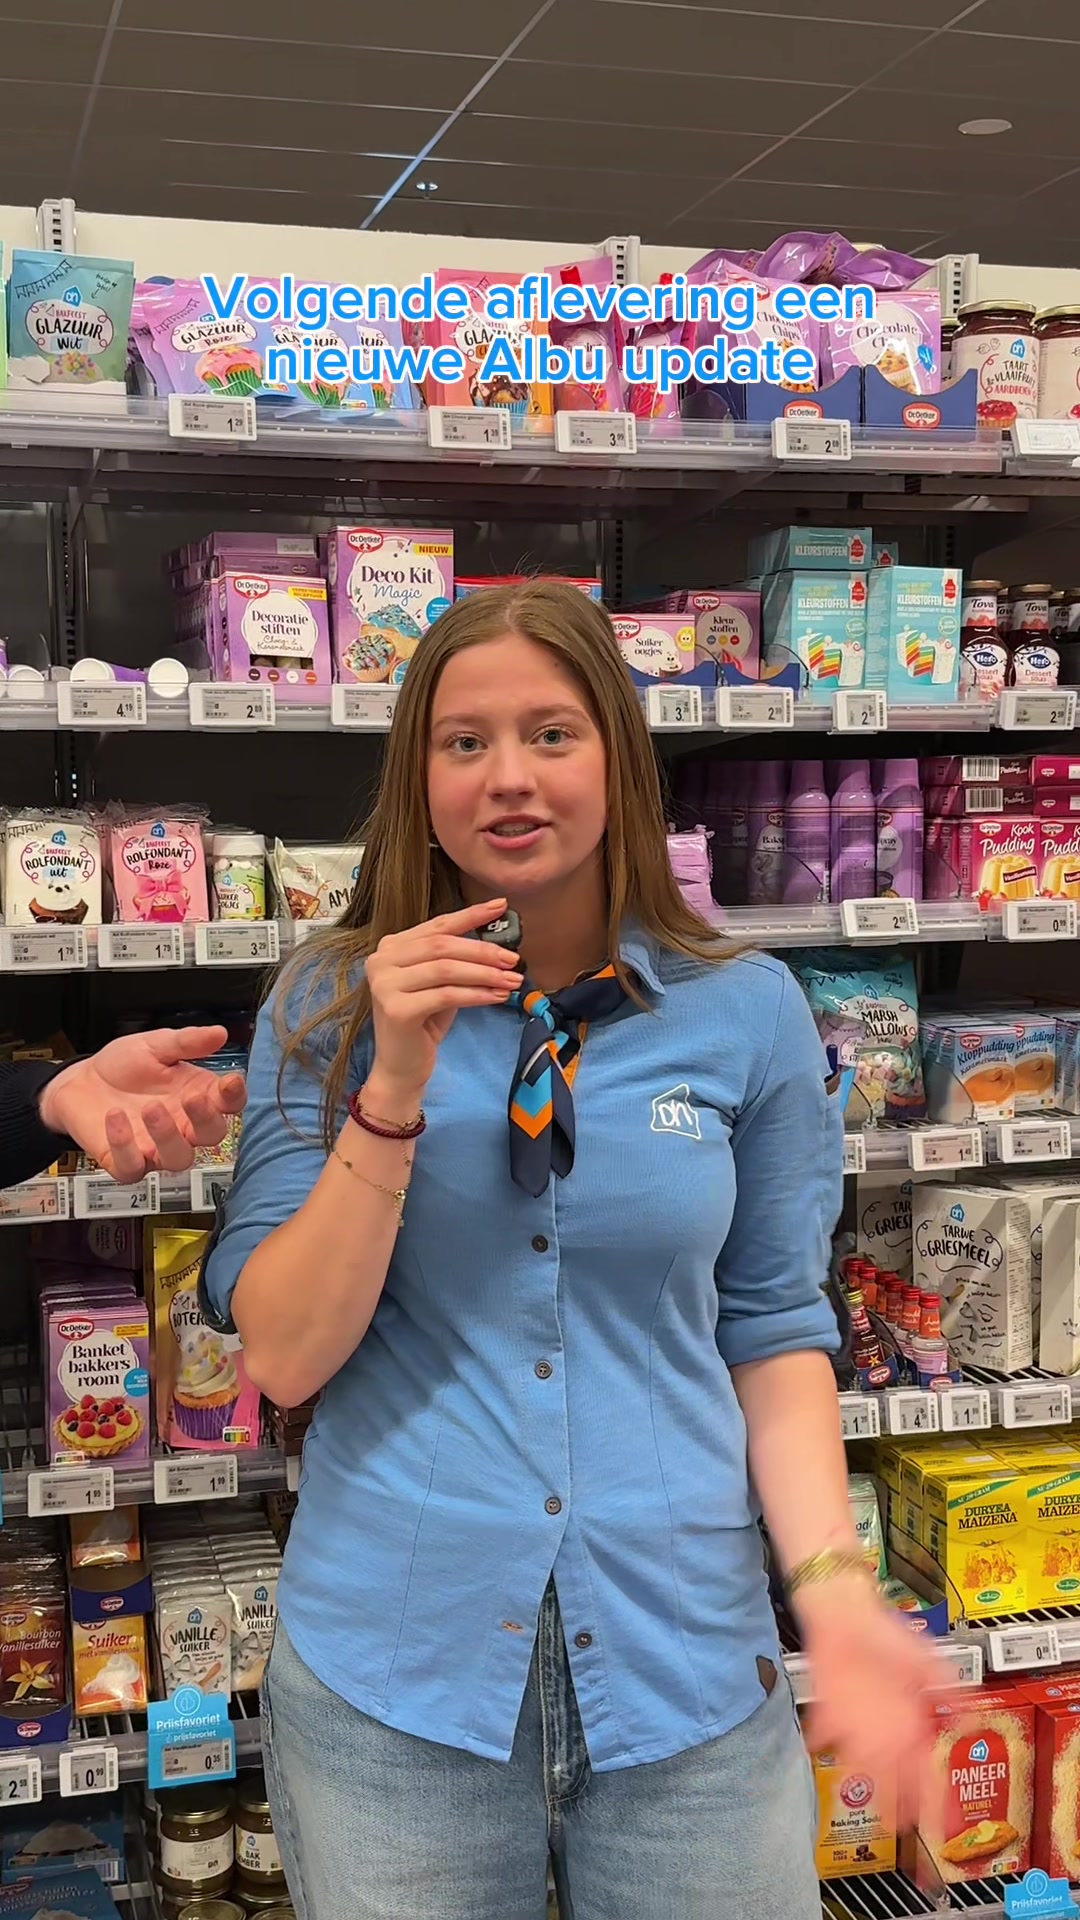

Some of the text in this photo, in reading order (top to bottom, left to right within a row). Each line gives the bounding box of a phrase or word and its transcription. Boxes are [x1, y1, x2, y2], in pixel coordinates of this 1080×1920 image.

[35, 318, 103, 340] GLAZUUR
[180, 324, 246, 345] GLAZUUR
[57, 337, 83, 350] Wit
[1003, 360, 1029, 372] TAART
[419, 545, 449, 554] NIEUW
[795, 545, 848, 557] KLEURSTOFFEN
[362, 565, 434, 584] Deco Kit
[373, 584, 422, 607] Magic
[897, 594, 942, 606] KLEURSTOFFEN
[798, 598, 849, 609] KLEURSTOFFEN
[971, 598, 994, 609] Tova
[1025, 602, 1047, 612] Tova
[252, 610, 309, 625] Decoratie
[713, 616, 736, 624] Kleur
[261, 623, 300, 636] stiften
[710, 624, 739, 633] stoffen
[635, 638, 664, 647] Suiker
[634, 647, 663, 657] oogjes
[1025, 669, 1052, 677] Dessert
[1011, 823, 1034, 837] Kook
[979, 837, 1035, 857] Pudding
[25, 855, 92, 871] ROLFONDANT
[126, 848, 192, 865] ROLFONDANT
[148, 860, 172, 871] Roze
[861, 1009, 899, 1023] MARSH
[956, 1039, 1015, 1066] Kloppudding
[941, 1224, 976, 1242] TARWE
[927, 1239, 991, 1268] GRIESMEEL
[72, 1343, 126, 1359] Banket
[68, 1358, 131, 1374] bakkers
[78, 1374, 120, 1388] room
[965, 1503, 1012, 1518] DURYEA
[958, 1511, 1018, 1530] MAIZENA
[20, 1629, 61, 1640] Bourbon
[88, 1633, 133, 1649] Suiker
[170, 1627, 218, 1645] VANILLE
[180, 1641, 210, 1653] SUIKER
[952, 1762, 1006, 1786] PANEER
[960, 1780, 998, 1802] MEEL
[848, 1809, 866, 1819] pure
[831, 1819, 860, 1828] Baking
